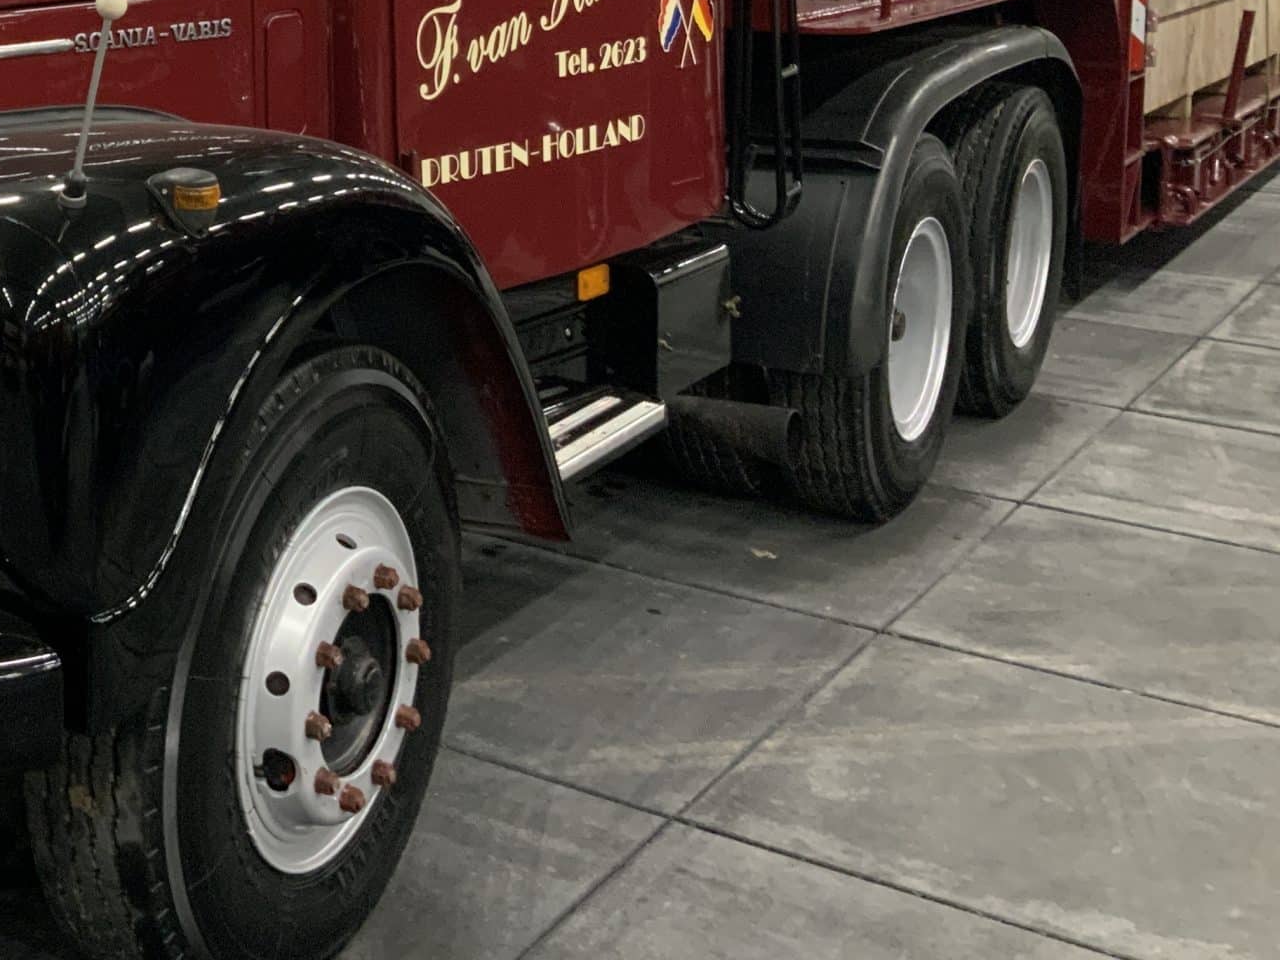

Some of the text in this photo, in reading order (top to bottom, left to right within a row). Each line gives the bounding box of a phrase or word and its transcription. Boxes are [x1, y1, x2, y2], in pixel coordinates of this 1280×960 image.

[467, 10, 532, 74] van
[554, 36, 648, 78] Tel. 2623
[421, 114, 646, 189] DRUTEN-HOLLAND
